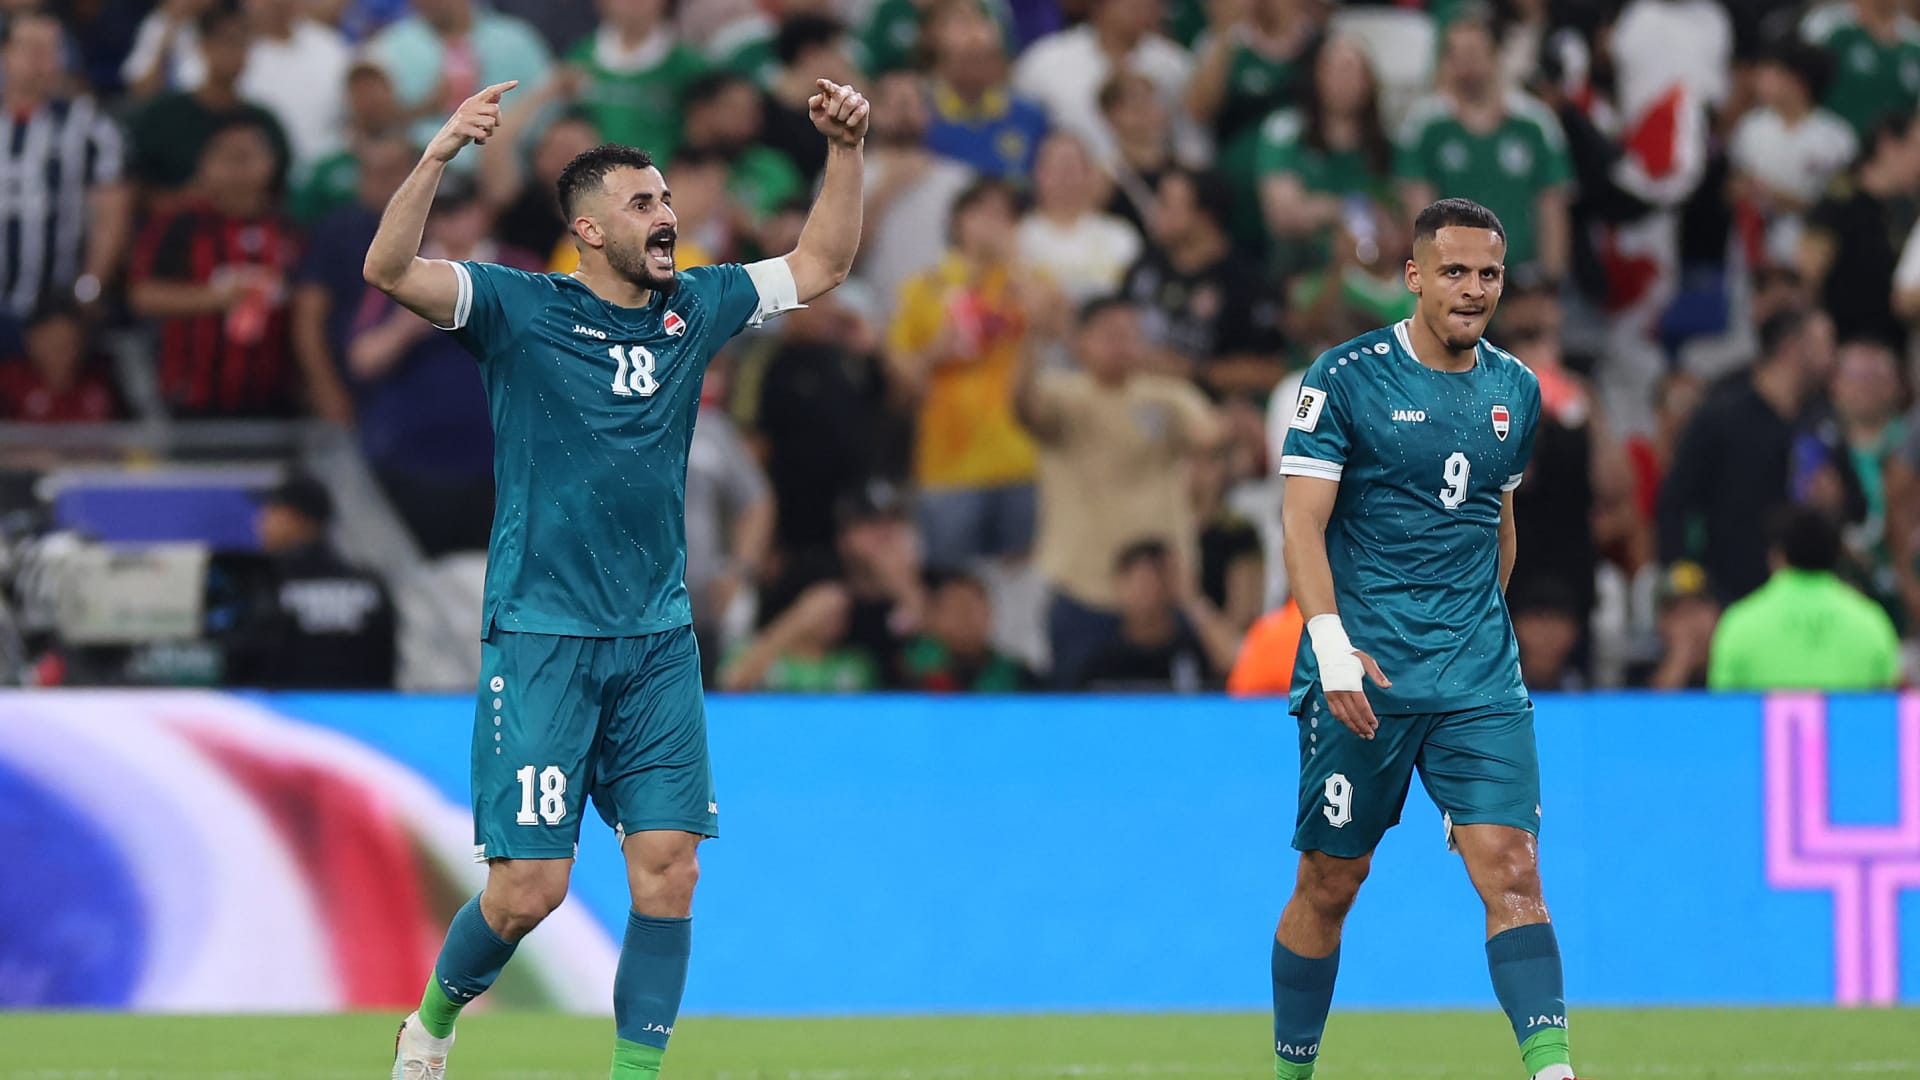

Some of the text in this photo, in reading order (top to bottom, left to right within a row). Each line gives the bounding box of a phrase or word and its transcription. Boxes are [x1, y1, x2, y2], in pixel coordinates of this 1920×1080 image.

[573, 324, 607, 341] JAKO
[608, 344, 660, 397] 18
[1392, 409, 1426, 422] JAKO
[1438, 451, 1471, 509] 9
[516, 765, 567, 826] 18
[1323, 772, 1354, 829] 9
[1276, 1040, 1318, 1057] JAKO
